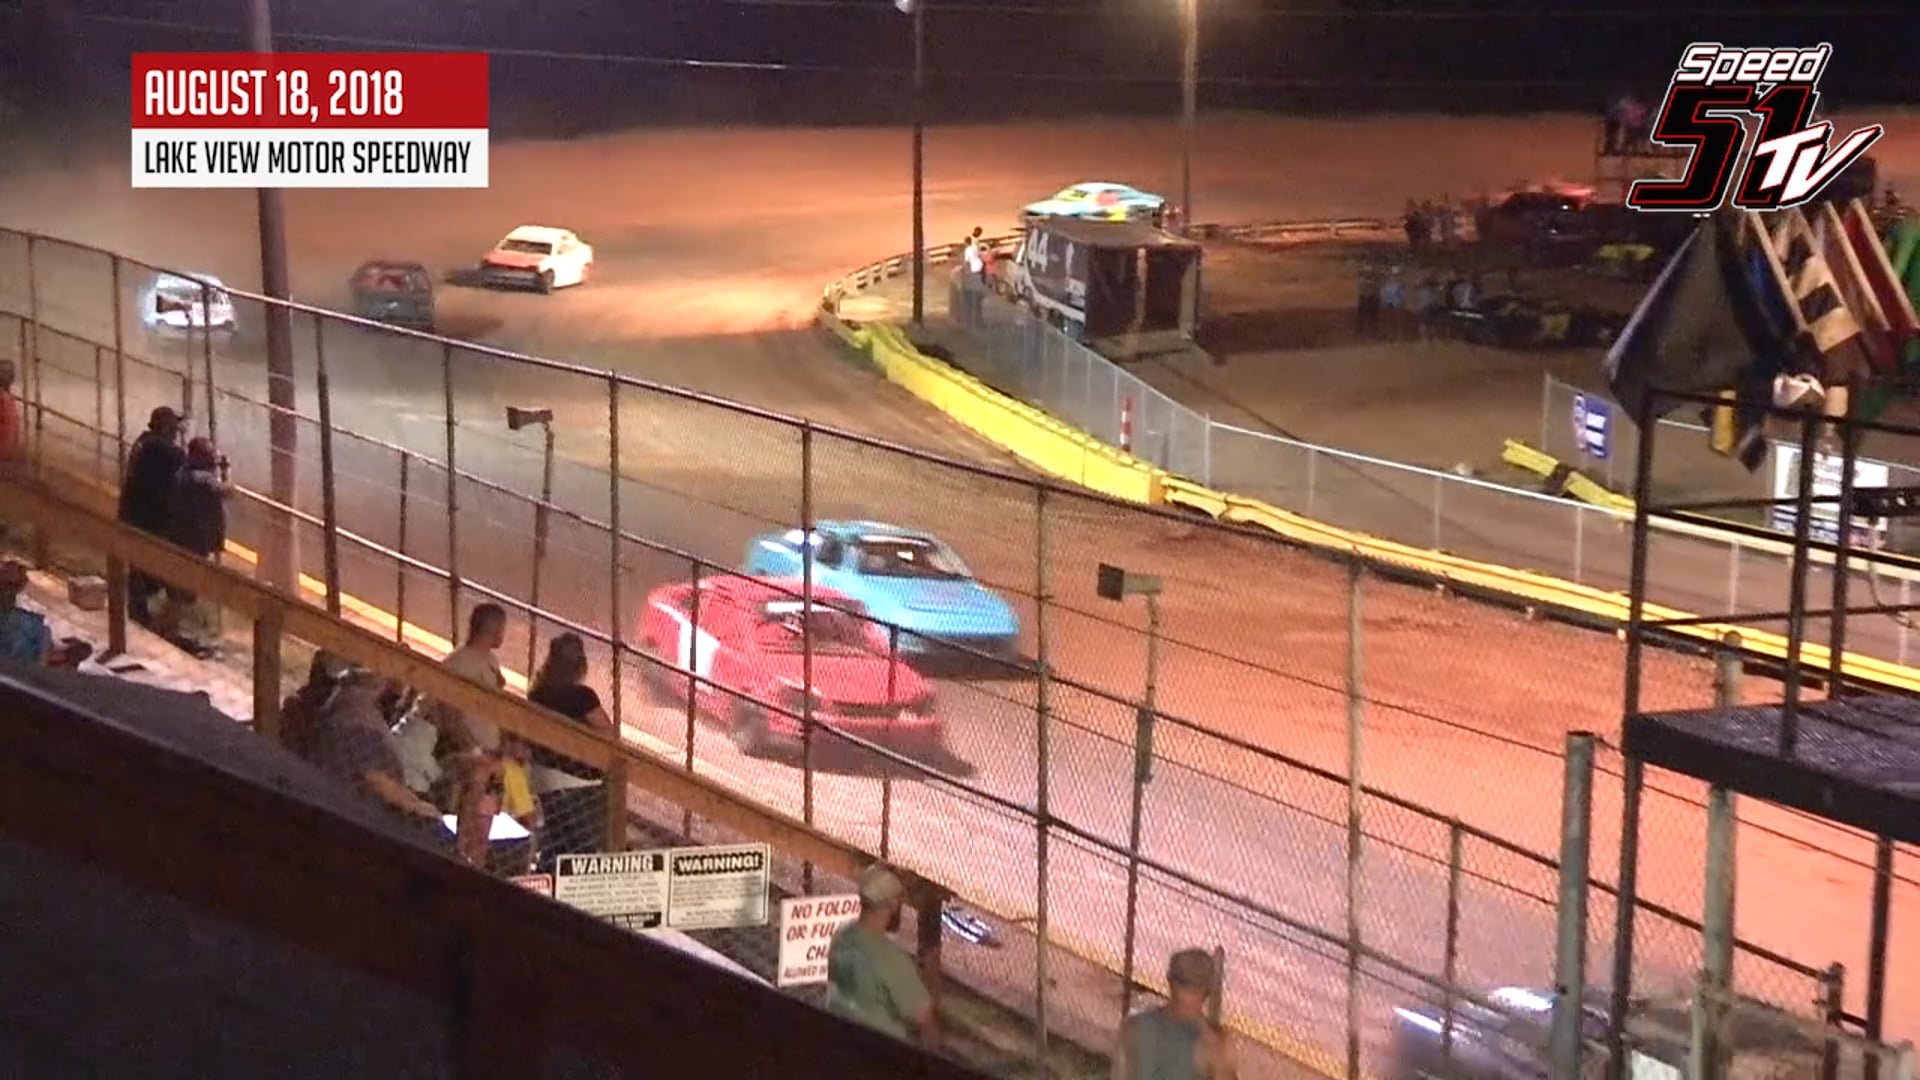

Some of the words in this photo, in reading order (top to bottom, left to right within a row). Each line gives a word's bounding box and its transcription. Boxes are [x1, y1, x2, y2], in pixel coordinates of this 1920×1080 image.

[572, 855, 654, 875] WARNING
[678, 855, 760, 873] WARNING!
[791, 903, 813, 919] NO
[786, 924, 808, 942] OR
